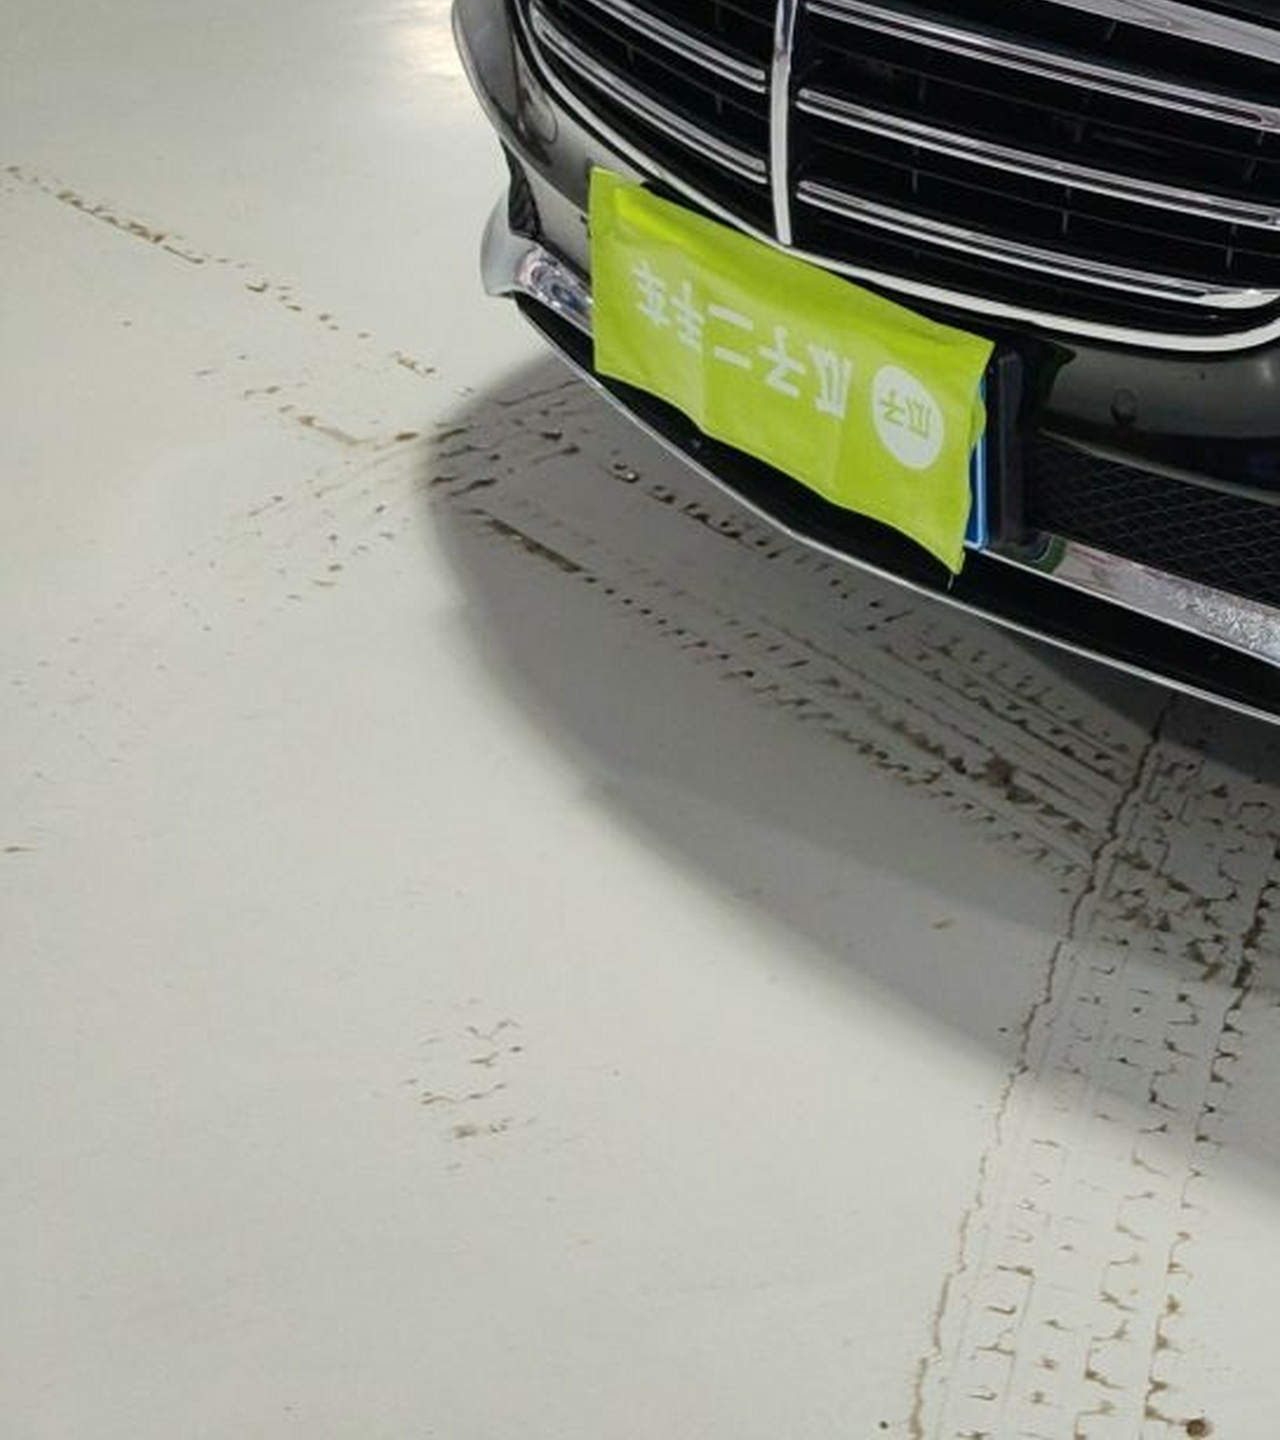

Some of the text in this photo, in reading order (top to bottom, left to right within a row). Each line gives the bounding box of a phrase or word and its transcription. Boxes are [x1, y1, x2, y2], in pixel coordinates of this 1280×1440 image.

[635, 261, 851, 418] 瓜子二手车
[879, 390, 931, 438] 瓜子
